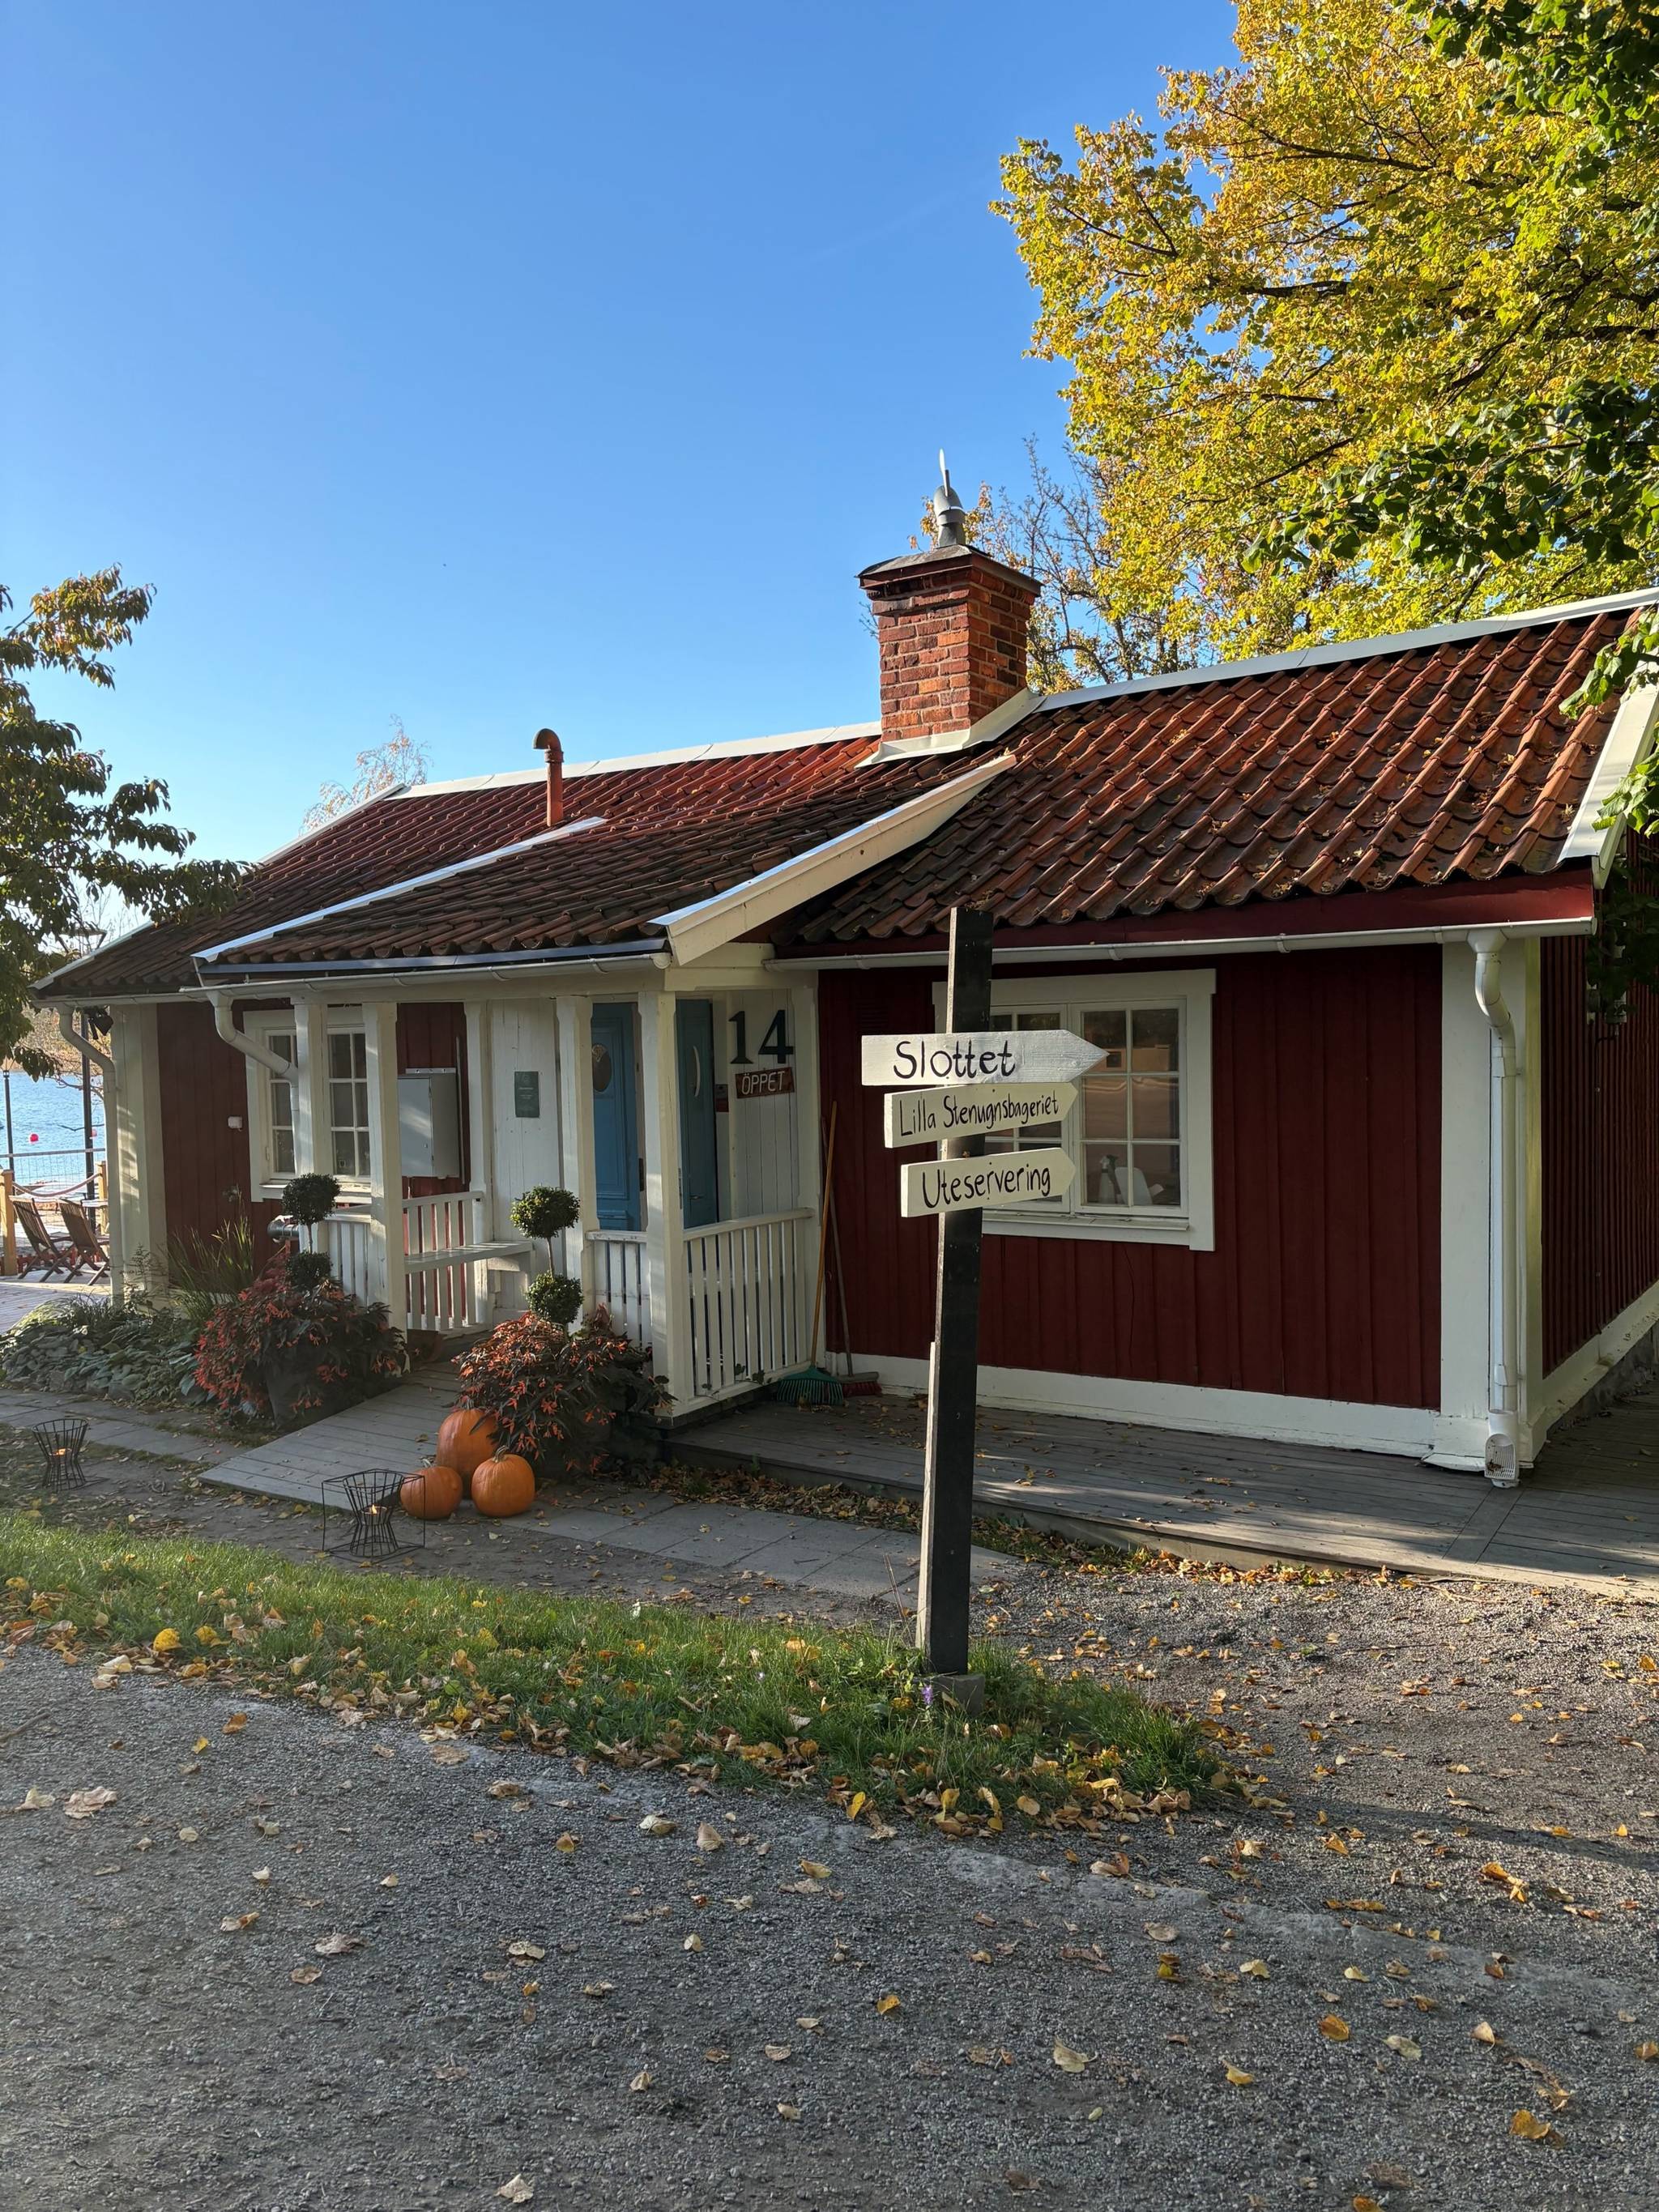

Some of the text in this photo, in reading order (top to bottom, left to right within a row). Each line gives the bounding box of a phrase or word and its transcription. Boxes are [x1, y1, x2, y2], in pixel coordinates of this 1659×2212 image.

[728, 1009, 795, 1064] 14
[893, 1040, 1016, 1079] Slottet
[741, 1071, 785, 1095] ÖPPET
[899, 1090, 1059, 1136] Lilla Stenugnsbageriet
[922, 1164, 1051, 1208] Uteservering
